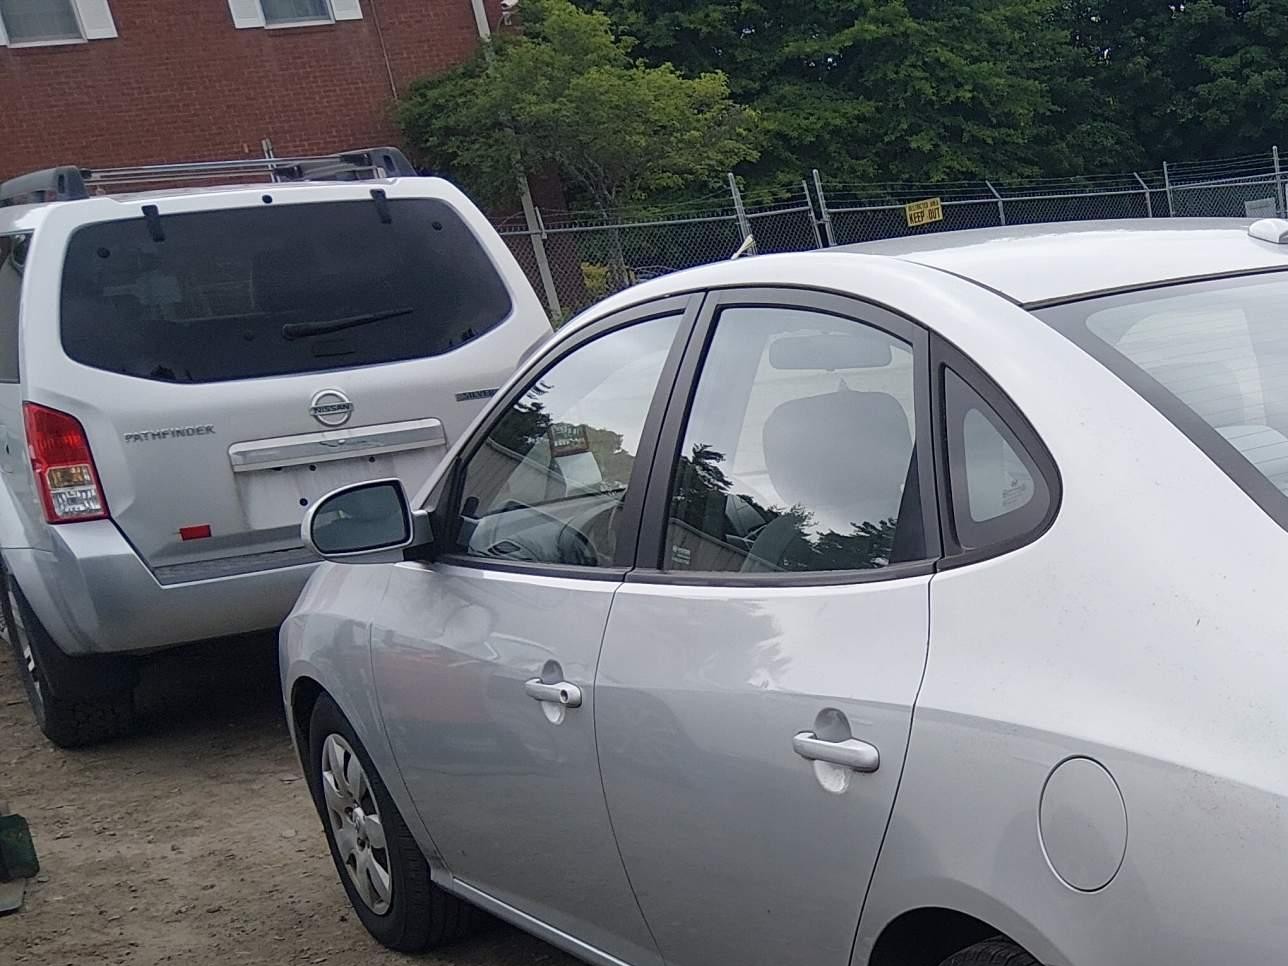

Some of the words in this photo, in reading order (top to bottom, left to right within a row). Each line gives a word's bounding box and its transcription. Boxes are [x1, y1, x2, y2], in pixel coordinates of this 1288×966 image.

[909, 210, 924, 225] KEEP
[928, 207, 941, 220] OUT
[313, 403, 350, 415] NISSAN
[124, 424, 217, 443] PATHFINDER
